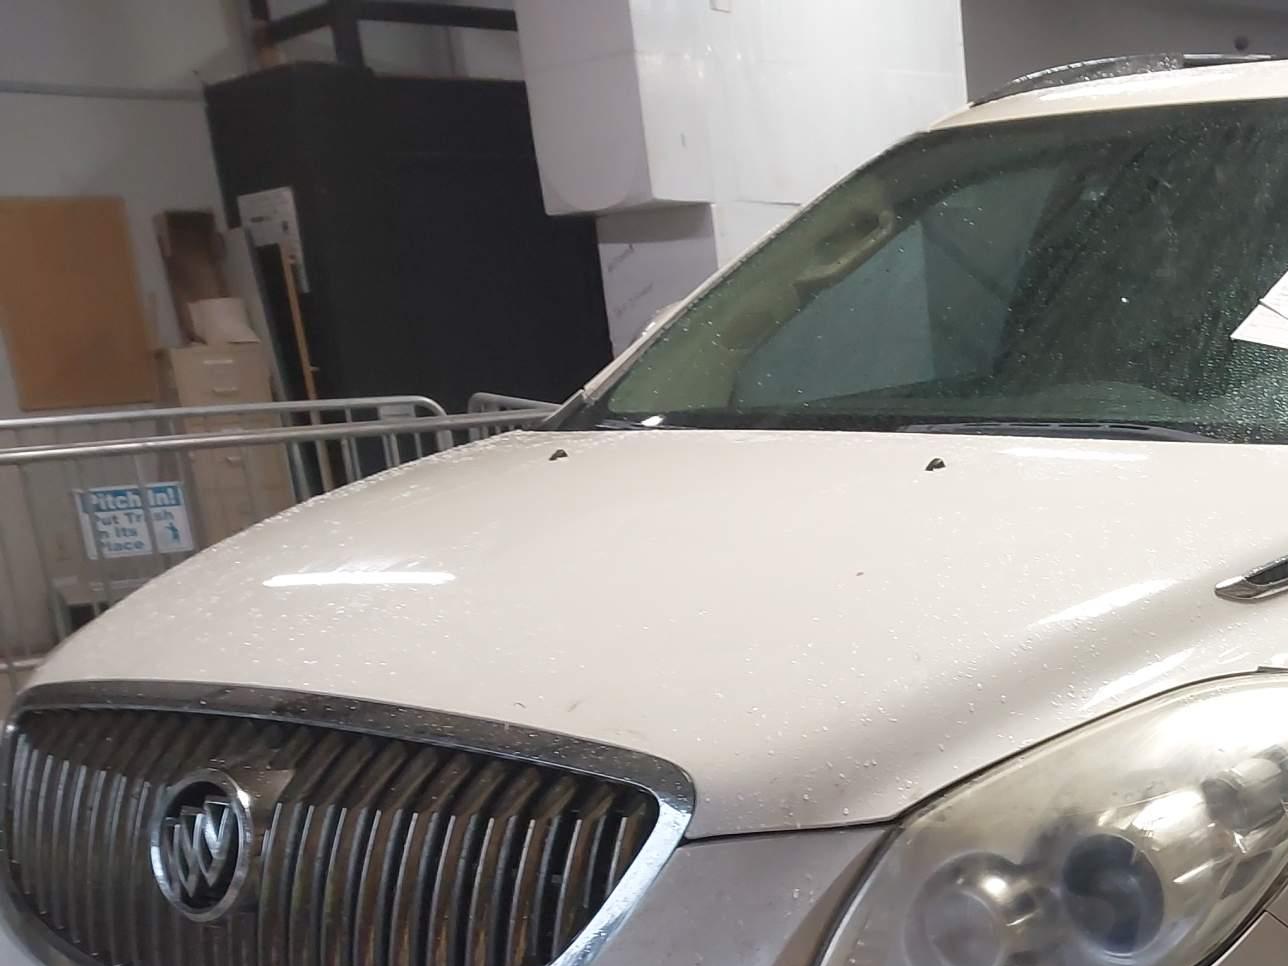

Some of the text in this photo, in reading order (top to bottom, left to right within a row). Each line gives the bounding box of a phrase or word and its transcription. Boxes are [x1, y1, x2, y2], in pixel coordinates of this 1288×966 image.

[148, 488, 176, 507] In!
[95, 510, 175, 526] ut Trsh
[98, 539, 145, 552] lace
